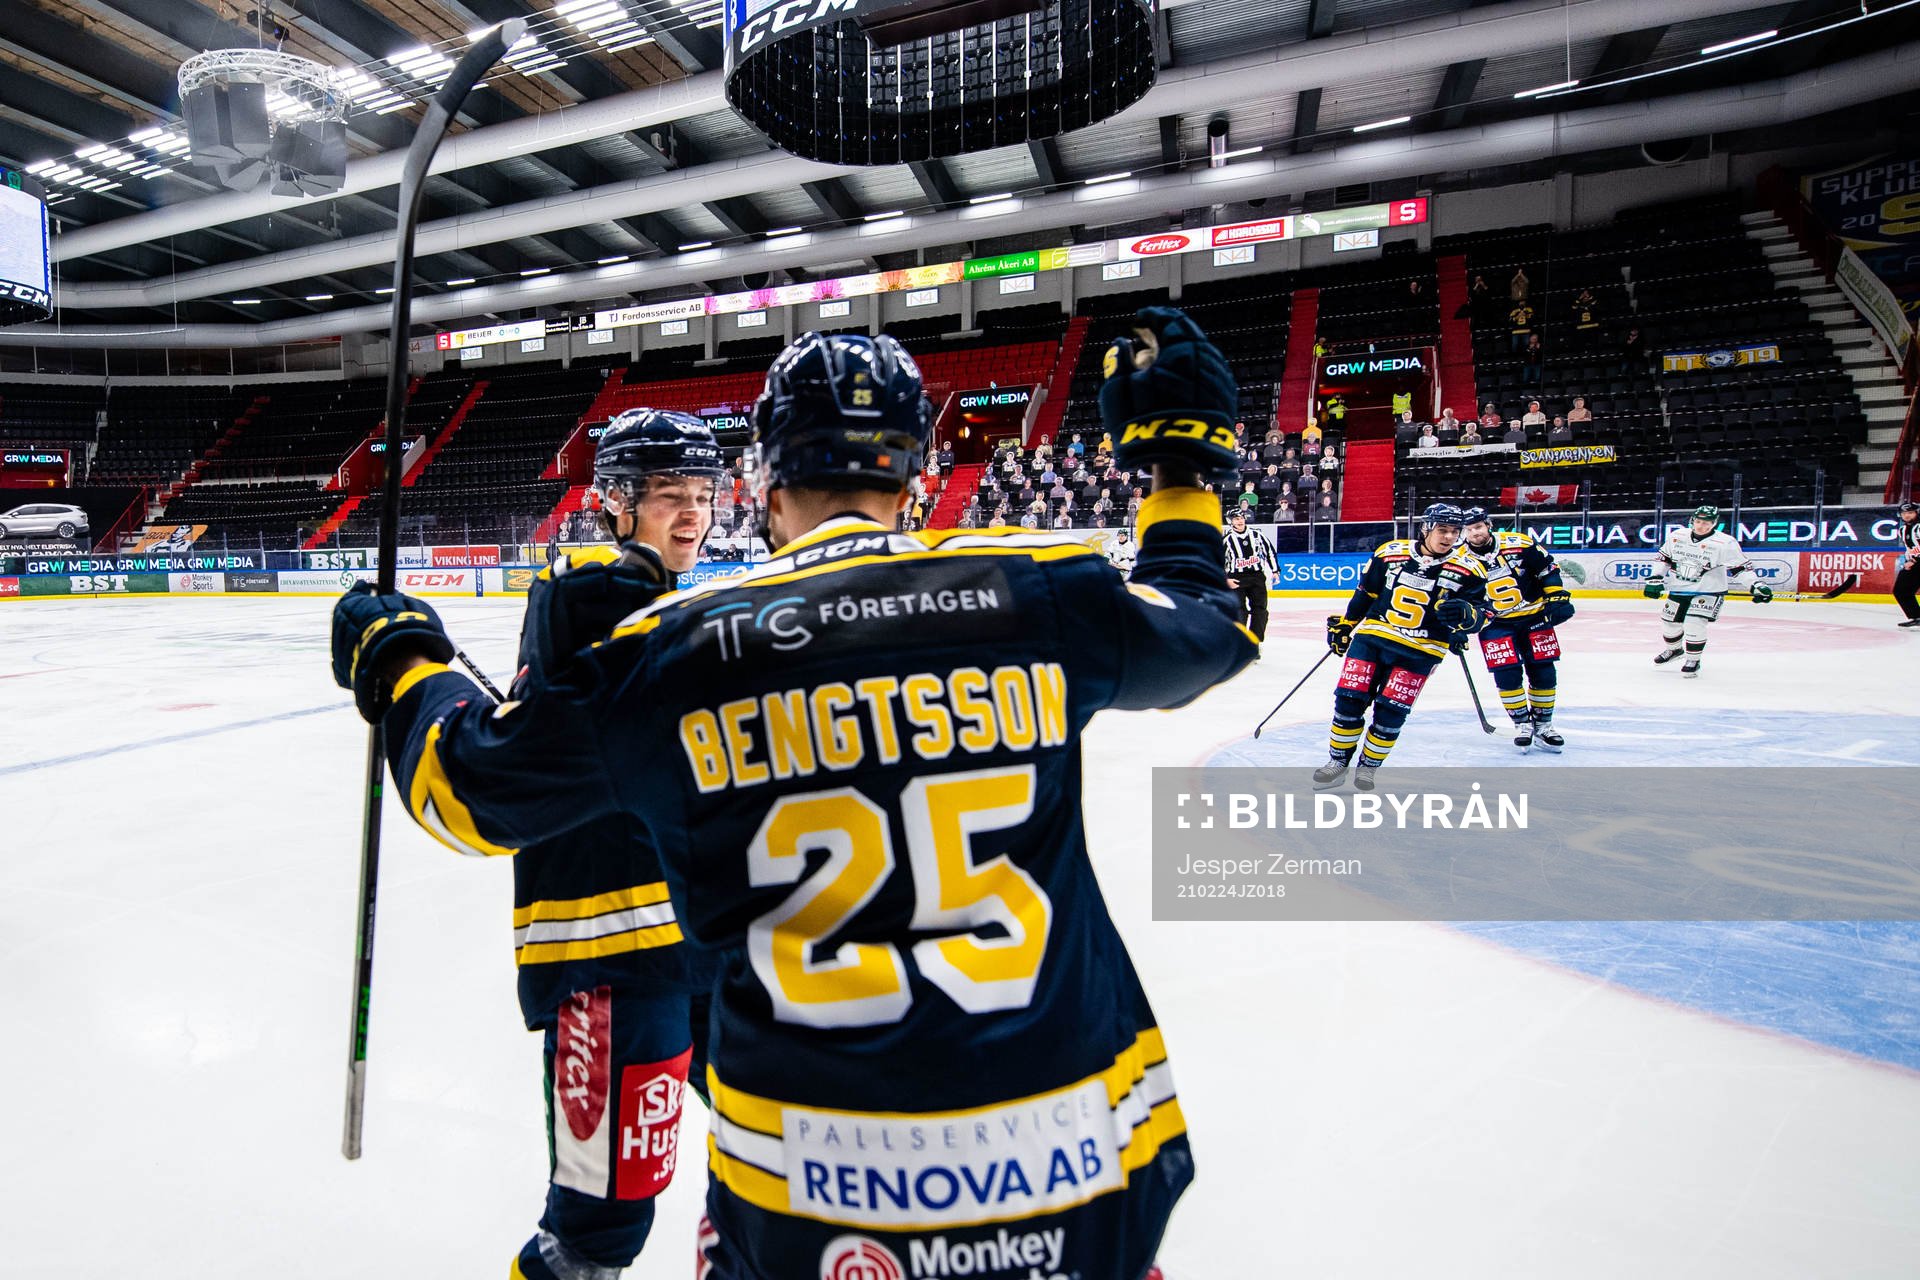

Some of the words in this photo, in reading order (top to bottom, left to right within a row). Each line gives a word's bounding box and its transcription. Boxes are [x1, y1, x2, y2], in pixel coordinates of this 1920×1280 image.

[1400, 202, 1416, 221] S
[1022, 256, 1035, 267] AB
[622, 307, 687, 321] Fordonsservice
[689, 303, 702, 312] AB
[1326, 361, 1365, 376] GRW
[1369, 357, 1422, 372] MEDIA
[960, 395, 989, 407] GRW
[991, 392, 1029, 405] MEDIA
[706, 416, 748, 430] MEDIA
[4, 454, 29, 463] GRW
[32, 454, 63, 463] MEDIA
[684, 447, 718, 458] CCM
[1527, 524, 1629, 545] MEDIA
[1737, 520, 1858, 542] MEDIA
[795, 536, 887, 566] CCM
[28, 560, 65, 573] GRW
[69, 560, 114, 572] MEDIA
[117, 559, 147, 570] GRW
[150, 558, 186, 570] MEDIA
[187, 557, 215, 569] GRW
[217, 556, 254, 568] MEDIA
[310, 552, 363, 570] BST
[434, 555, 472, 566] VIKING
[474, 555, 498, 565] LINE
[1809, 553, 1886, 571] NORDISK
[69, 574, 130, 592] BST
[192, 573, 213, 583] Monkey
[192, 581, 214, 591] Sports
[405, 574, 465, 586] CCM
[1485, 576, 1523, 611] S
[818, 588, 1000, 625] FÖRETAGEN
[1385, 584, 1431, 629] S
[1485, 649, 1515, 661] Huset
[679, 662, 1068, 794] BENGTSSON
[746, 764, 1053, 1029] 25
[565, 988, 599, 1111] eritex
[798, 1092, 1094, 1151] PALLSERVICE
[803, 1157, 1033, 1212] RENOVA
[1045, 1136, 1104, 1194] AB
[908, 1227, 1065, 1278] Monkey
